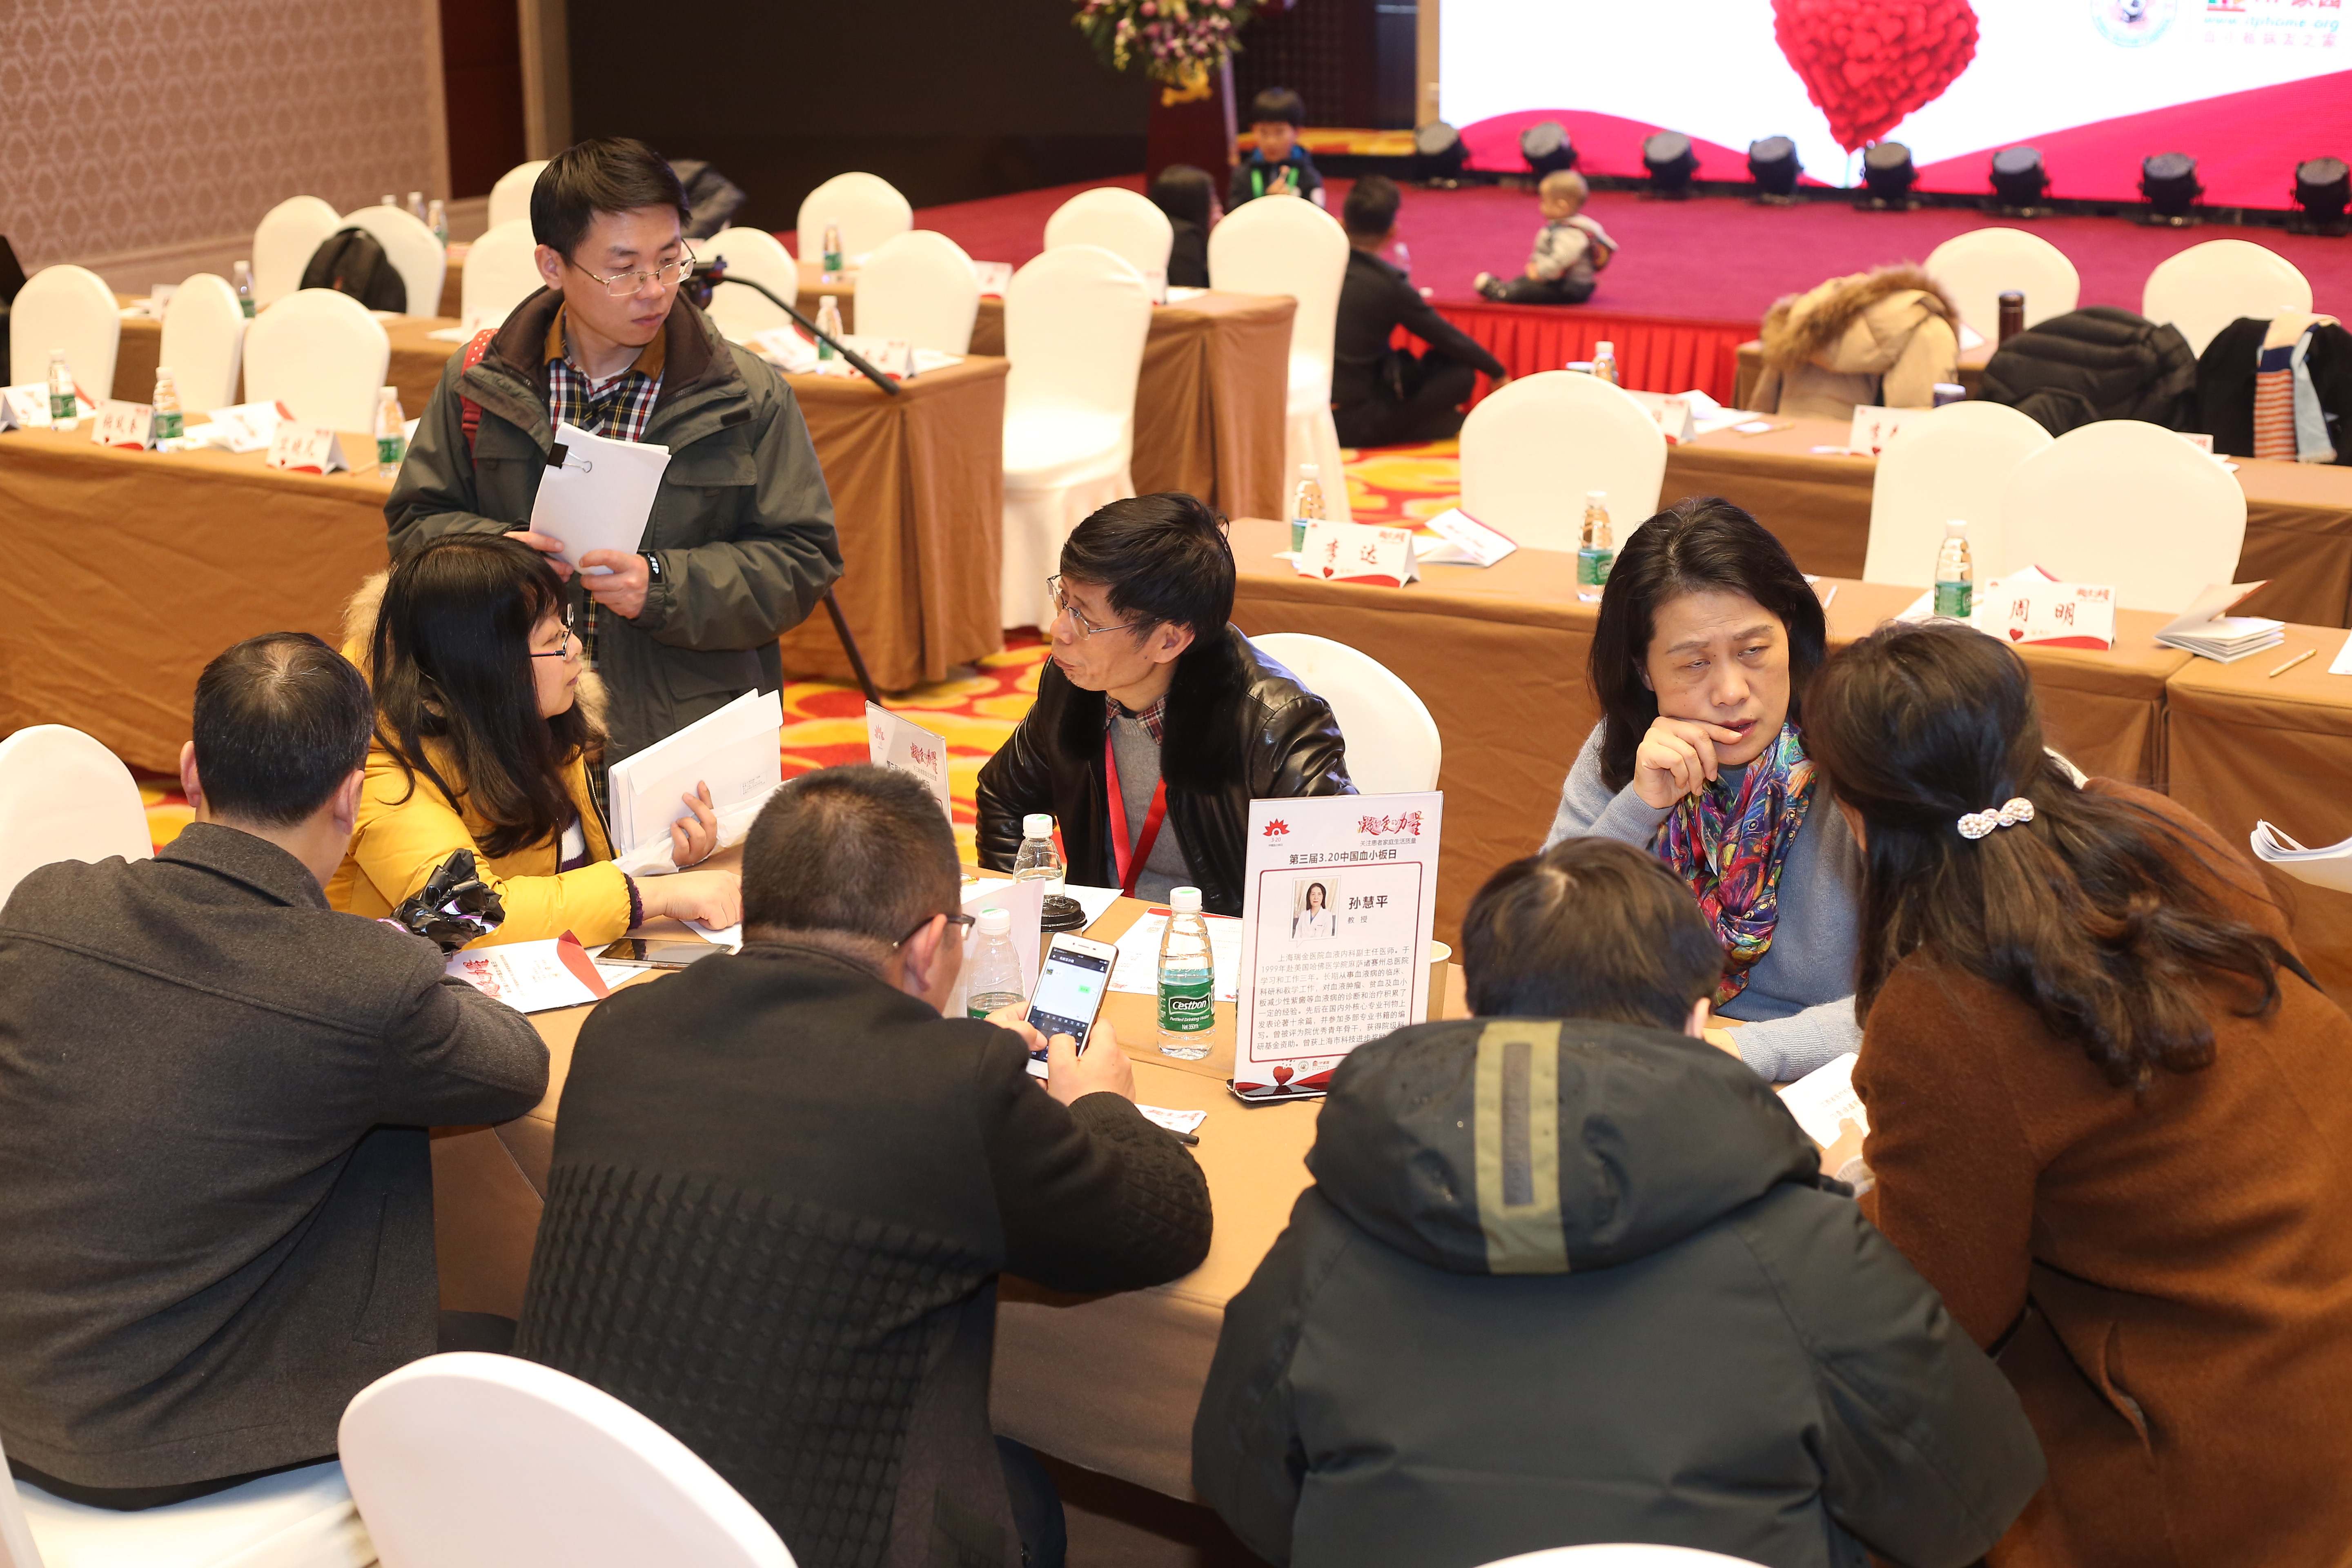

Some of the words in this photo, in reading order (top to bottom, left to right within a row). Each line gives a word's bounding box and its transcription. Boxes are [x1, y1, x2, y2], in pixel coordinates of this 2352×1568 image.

[2009, 598, 2075, 627] 周明
[1359, 837, 1417, 846] 关注患者家庭生活质量
[1289, 849, 1397, 865] 第三届3.20中国血小板日
[1348, 895, 1388, 910] 孙慧平
[1348, 915, 1368, 924] 教授
